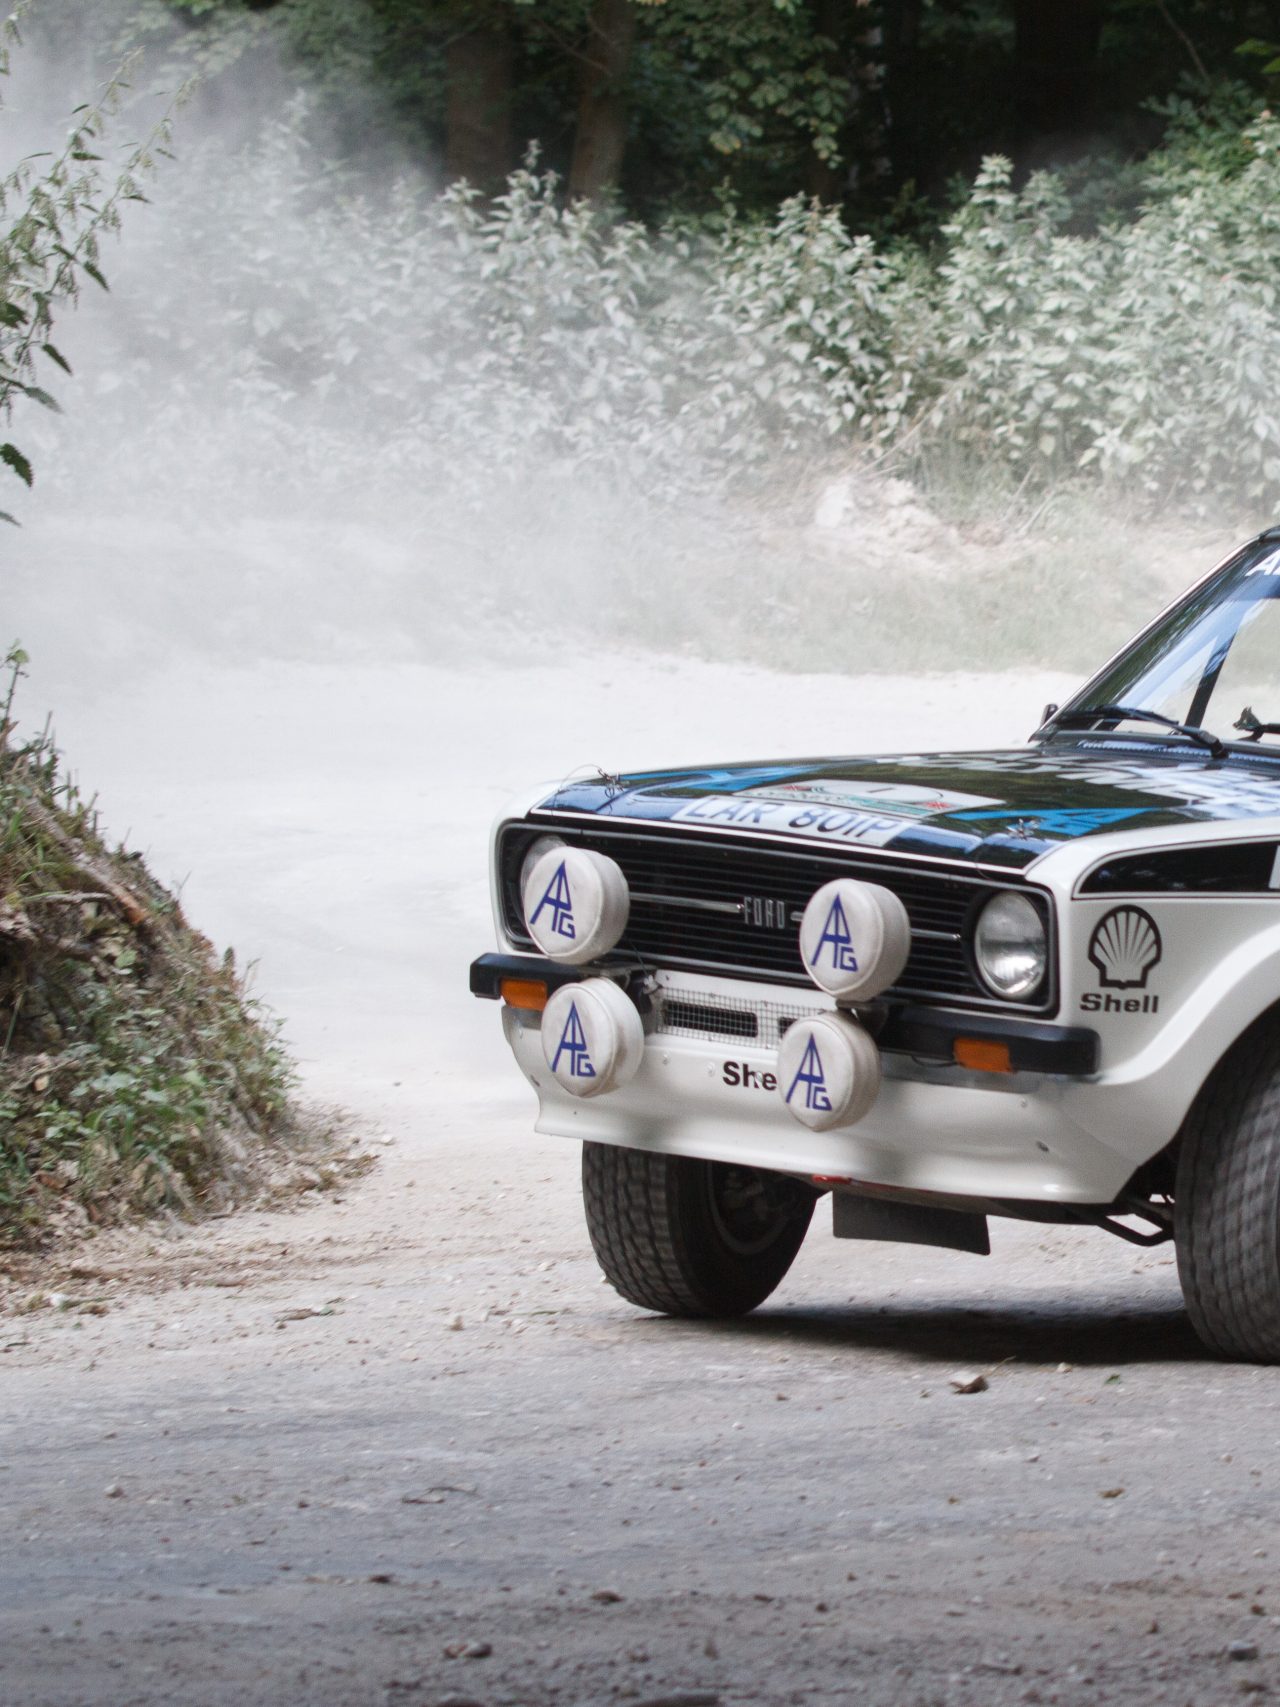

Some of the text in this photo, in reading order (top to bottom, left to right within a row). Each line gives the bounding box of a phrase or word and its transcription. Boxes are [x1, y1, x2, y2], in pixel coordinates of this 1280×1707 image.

[744, 896, 785, 929] FORD
[1080, 993, 1159, 1013] Shell
[722, 1061, 777, 1091] She
